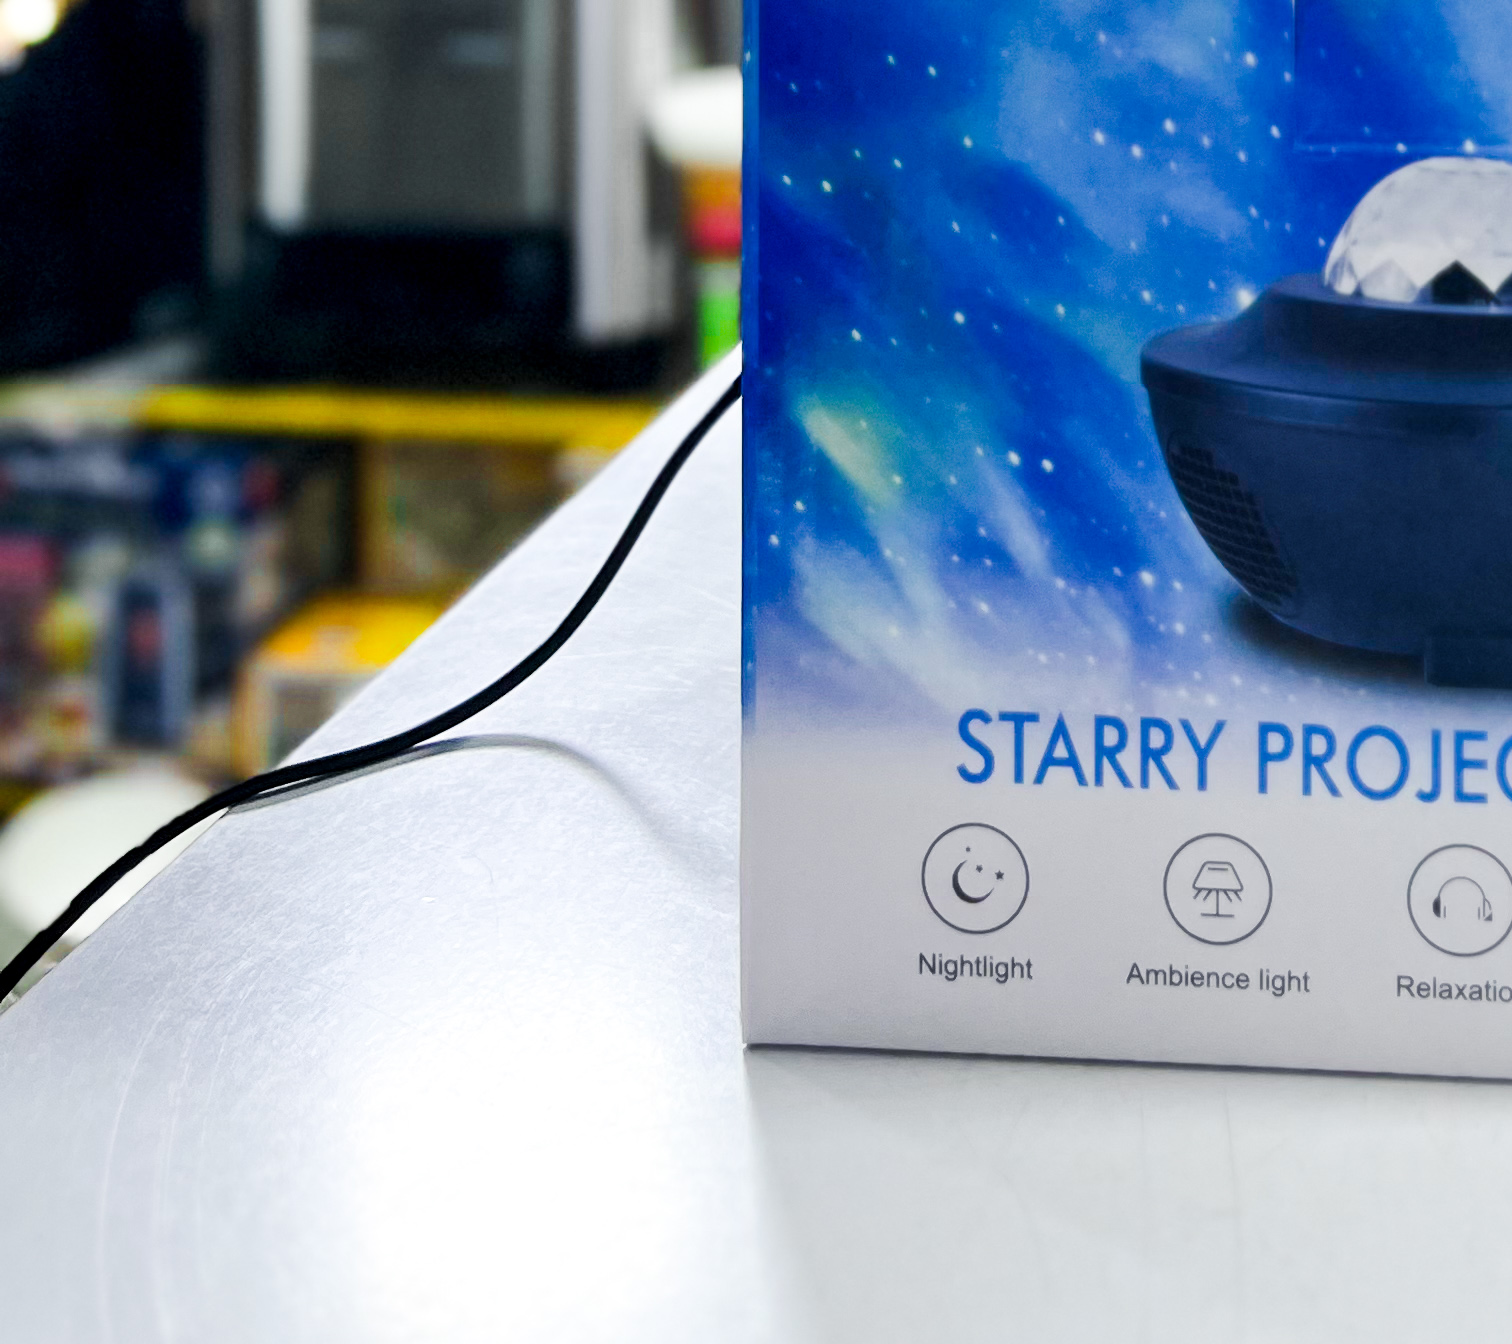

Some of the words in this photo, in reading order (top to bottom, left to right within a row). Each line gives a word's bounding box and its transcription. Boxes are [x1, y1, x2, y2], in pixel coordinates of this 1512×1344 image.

[957, 708, 1228, 793] STARRY
[919, 952, 1034, 985] Nightlight
[1127, 962, 1250, 991] Ambience
[1259, 968, 1311, 999] light
